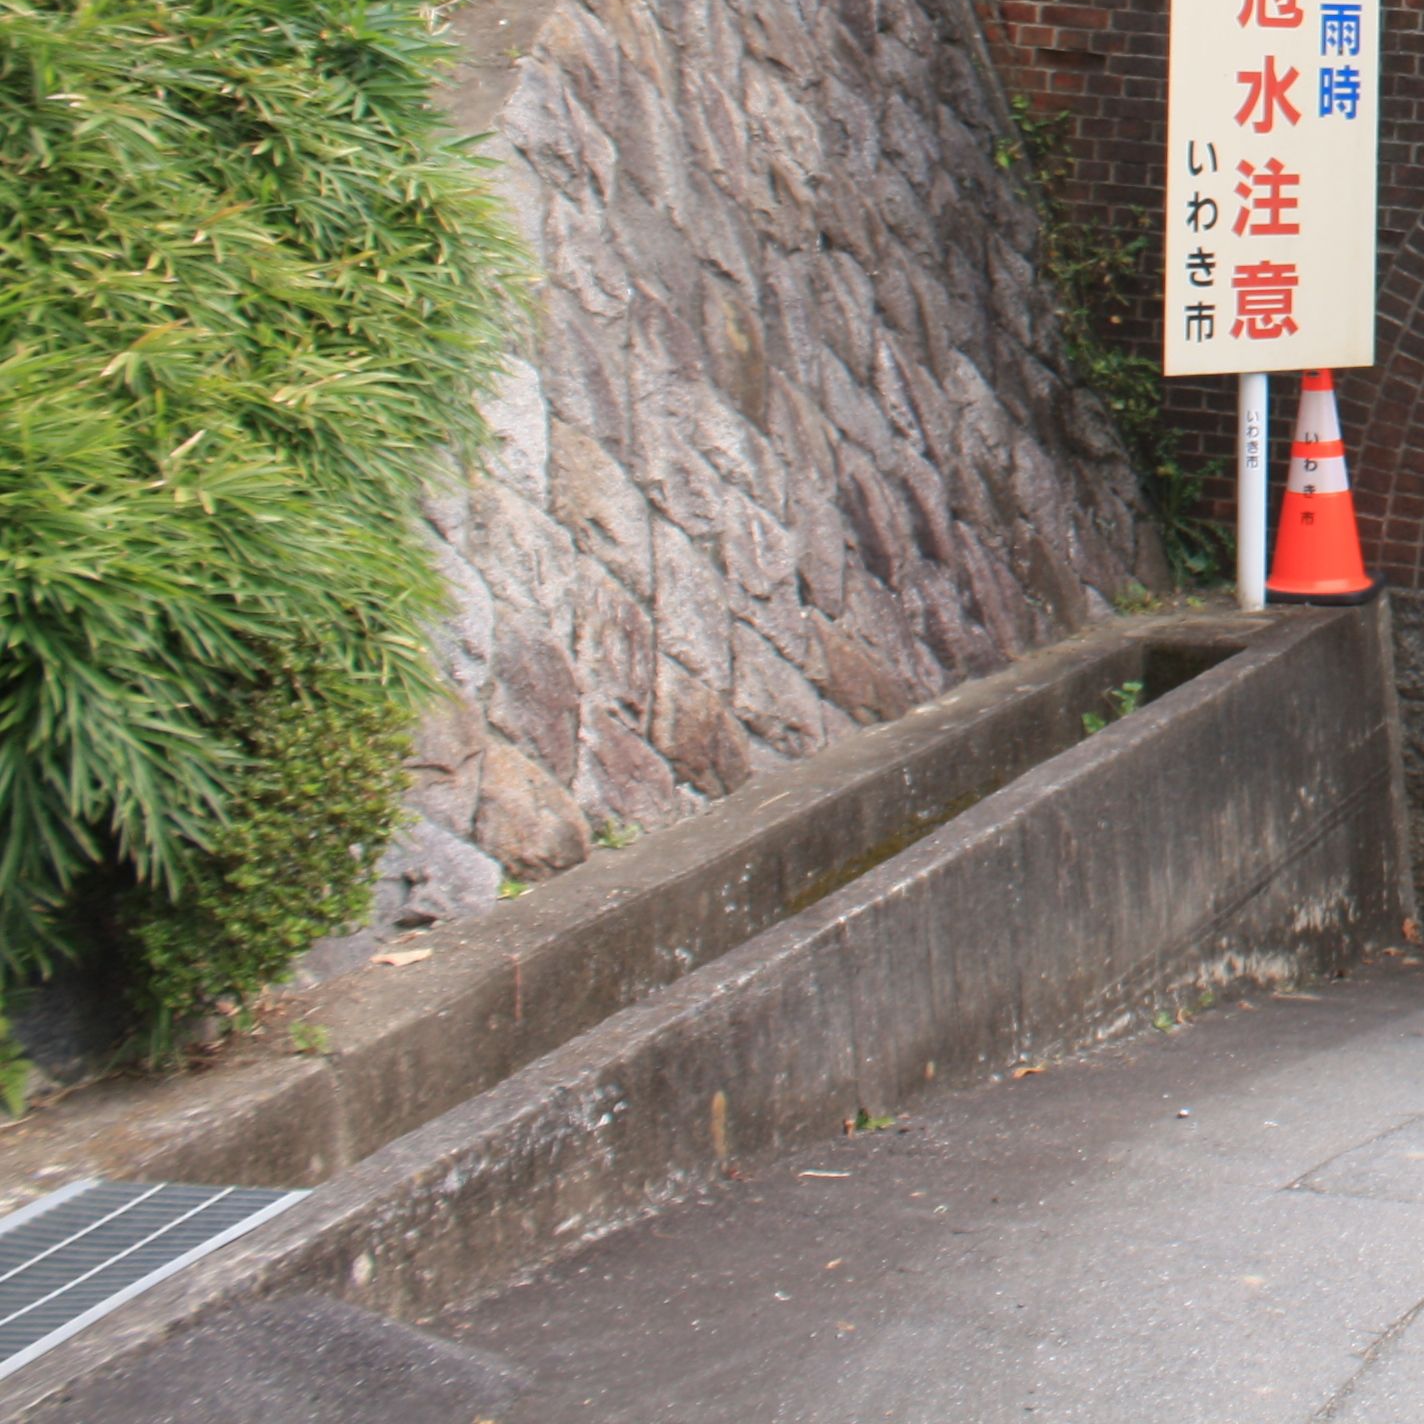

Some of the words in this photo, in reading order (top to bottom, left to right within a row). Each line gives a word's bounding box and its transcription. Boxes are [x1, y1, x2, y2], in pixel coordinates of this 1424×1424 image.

[1184, 139, 1219, 343] いわき市
[1246, 409, 1260, 468] いわき市
[1300, 430, 1319, 526] いわき市
